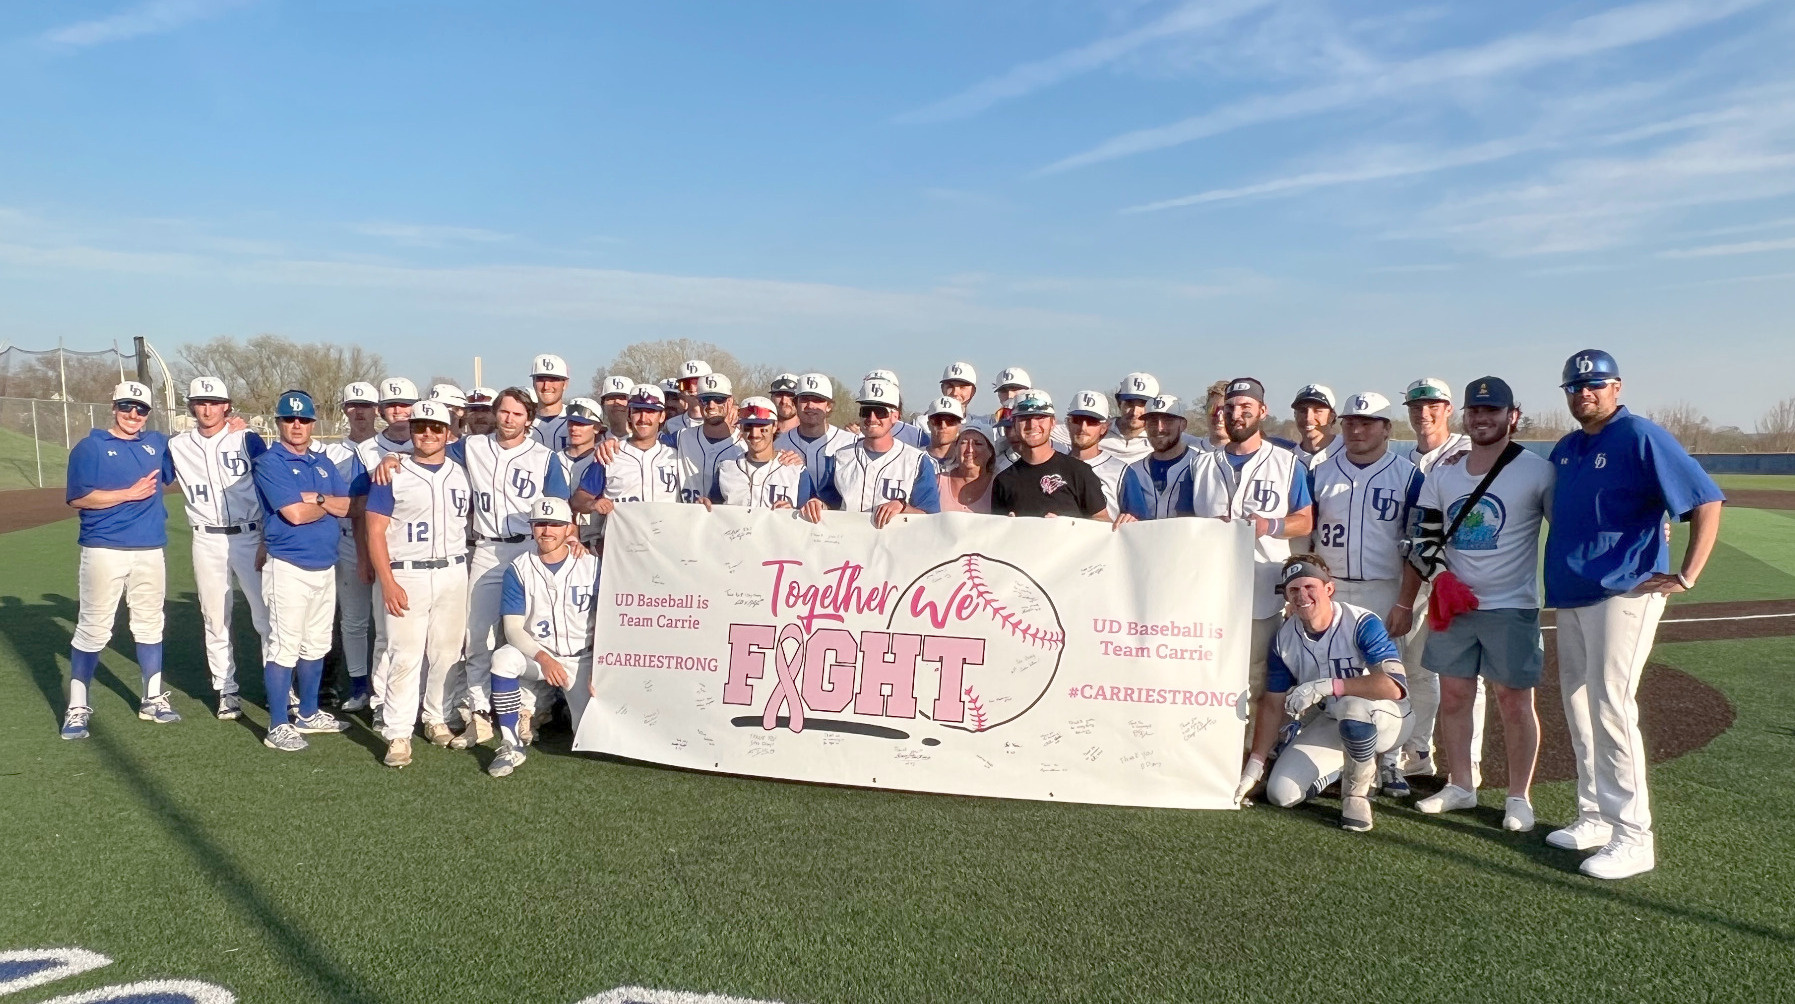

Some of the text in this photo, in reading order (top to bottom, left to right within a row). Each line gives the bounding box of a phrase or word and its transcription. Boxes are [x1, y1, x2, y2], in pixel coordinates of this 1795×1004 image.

[542, 359, 554, 371] UD
[951, 364, 962, 376] UD
[1576, 356, 1593, 374] UD
[130, 385, 142, 396] UD
[201, 380, 214, 392] UD
[352, 385, 364, 396] UD
[389, 384, 402, 395] UD
[705, 376, 717, 389] UD
[807, 376, 818, 389] UD
[871, 384, 884, 397] UD
[1134, 377, 1146, 391] UD
[289, 398, 303, 412] UD
[1083, 394, 1095, 407] UD
[1356, 397, 1369, 411] UD
[422, 404, 434, 416] UD
[221, 452, 248, 477] UD
[512, 468, 536, 499] UD
[657, 466, 677, 493] UD
[188, 485, 208, 503] 14
[881, 478, 907, 500] UD
[1252, 479, 1280, 512] UD
[450, 488, 467, 518] UD
[542, 501, 553, 515] UD
[1372, 487, 1399, 521] UD
[408, 522, 429, 542] 12
[1321, 524, 1345, 548] 32
[570, 585, 592, 613] UD
[615, 593, 634, 607] UD
[637, 594, 694, 609] Baseball
[697, 595, 709, 609] is
[762, 560, 898, 635] Together
[910, 581, 980, 629] We
[537, 620, 550, 638] 3
[619, 614, 700, 630] Team Carrie
[1093, 619, 1223, 639] UD Baseball is
[1100, 640, 1213, 661] Team Carrie
[597, 652, 718, 672] #CARRIESTRONG
[1068, 684, 1237, 707] #CARRIESTRONG
